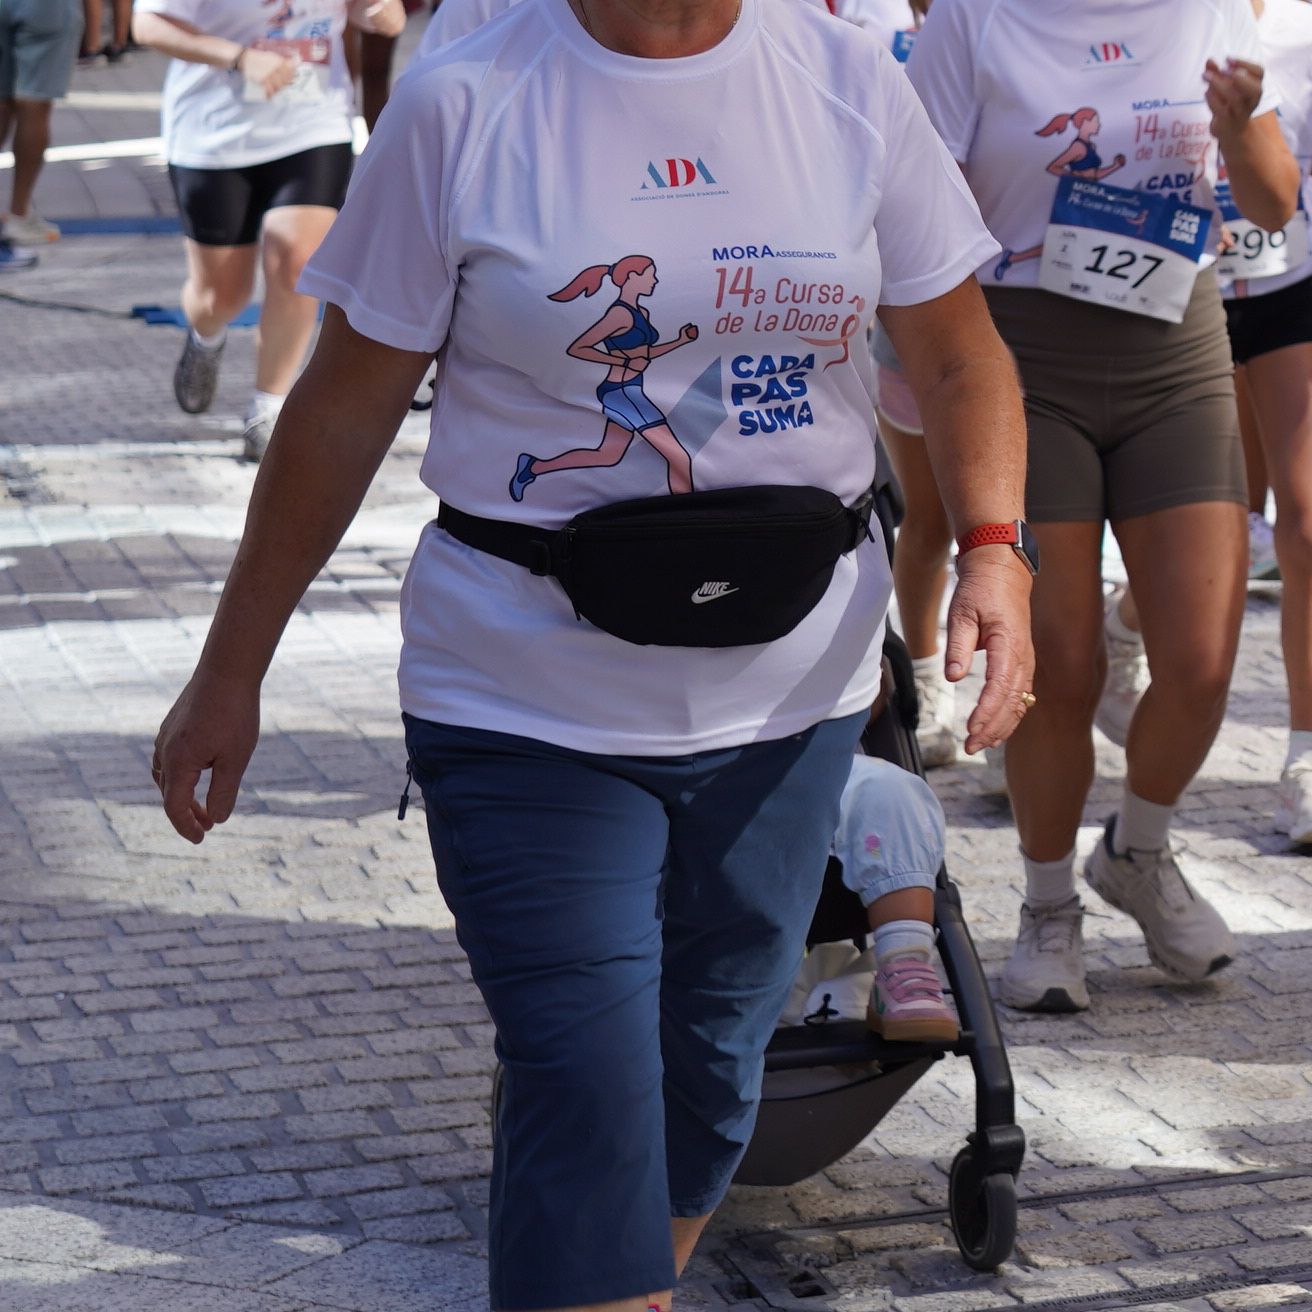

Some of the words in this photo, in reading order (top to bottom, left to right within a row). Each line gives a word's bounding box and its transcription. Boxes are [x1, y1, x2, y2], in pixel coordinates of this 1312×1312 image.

[640, 155, 718, 190] ADA
[712, 244, 775, 261] MORA
[775, 250, 837, 260] ASSEGURANCES
[1084, 244, 1165, 290] 127
[775, 278, 844, 305] Cursa
[715, 312, 744, 335] de
[754, 310, 779, 332] la
[782, 308, 839, 333] Dona
[731, 353, 815, 379] CADA
[731, 371, 809, 406] PAS
[739, 400, 814, 436] SUMA
[699, 581, 731, 596] NIKE
